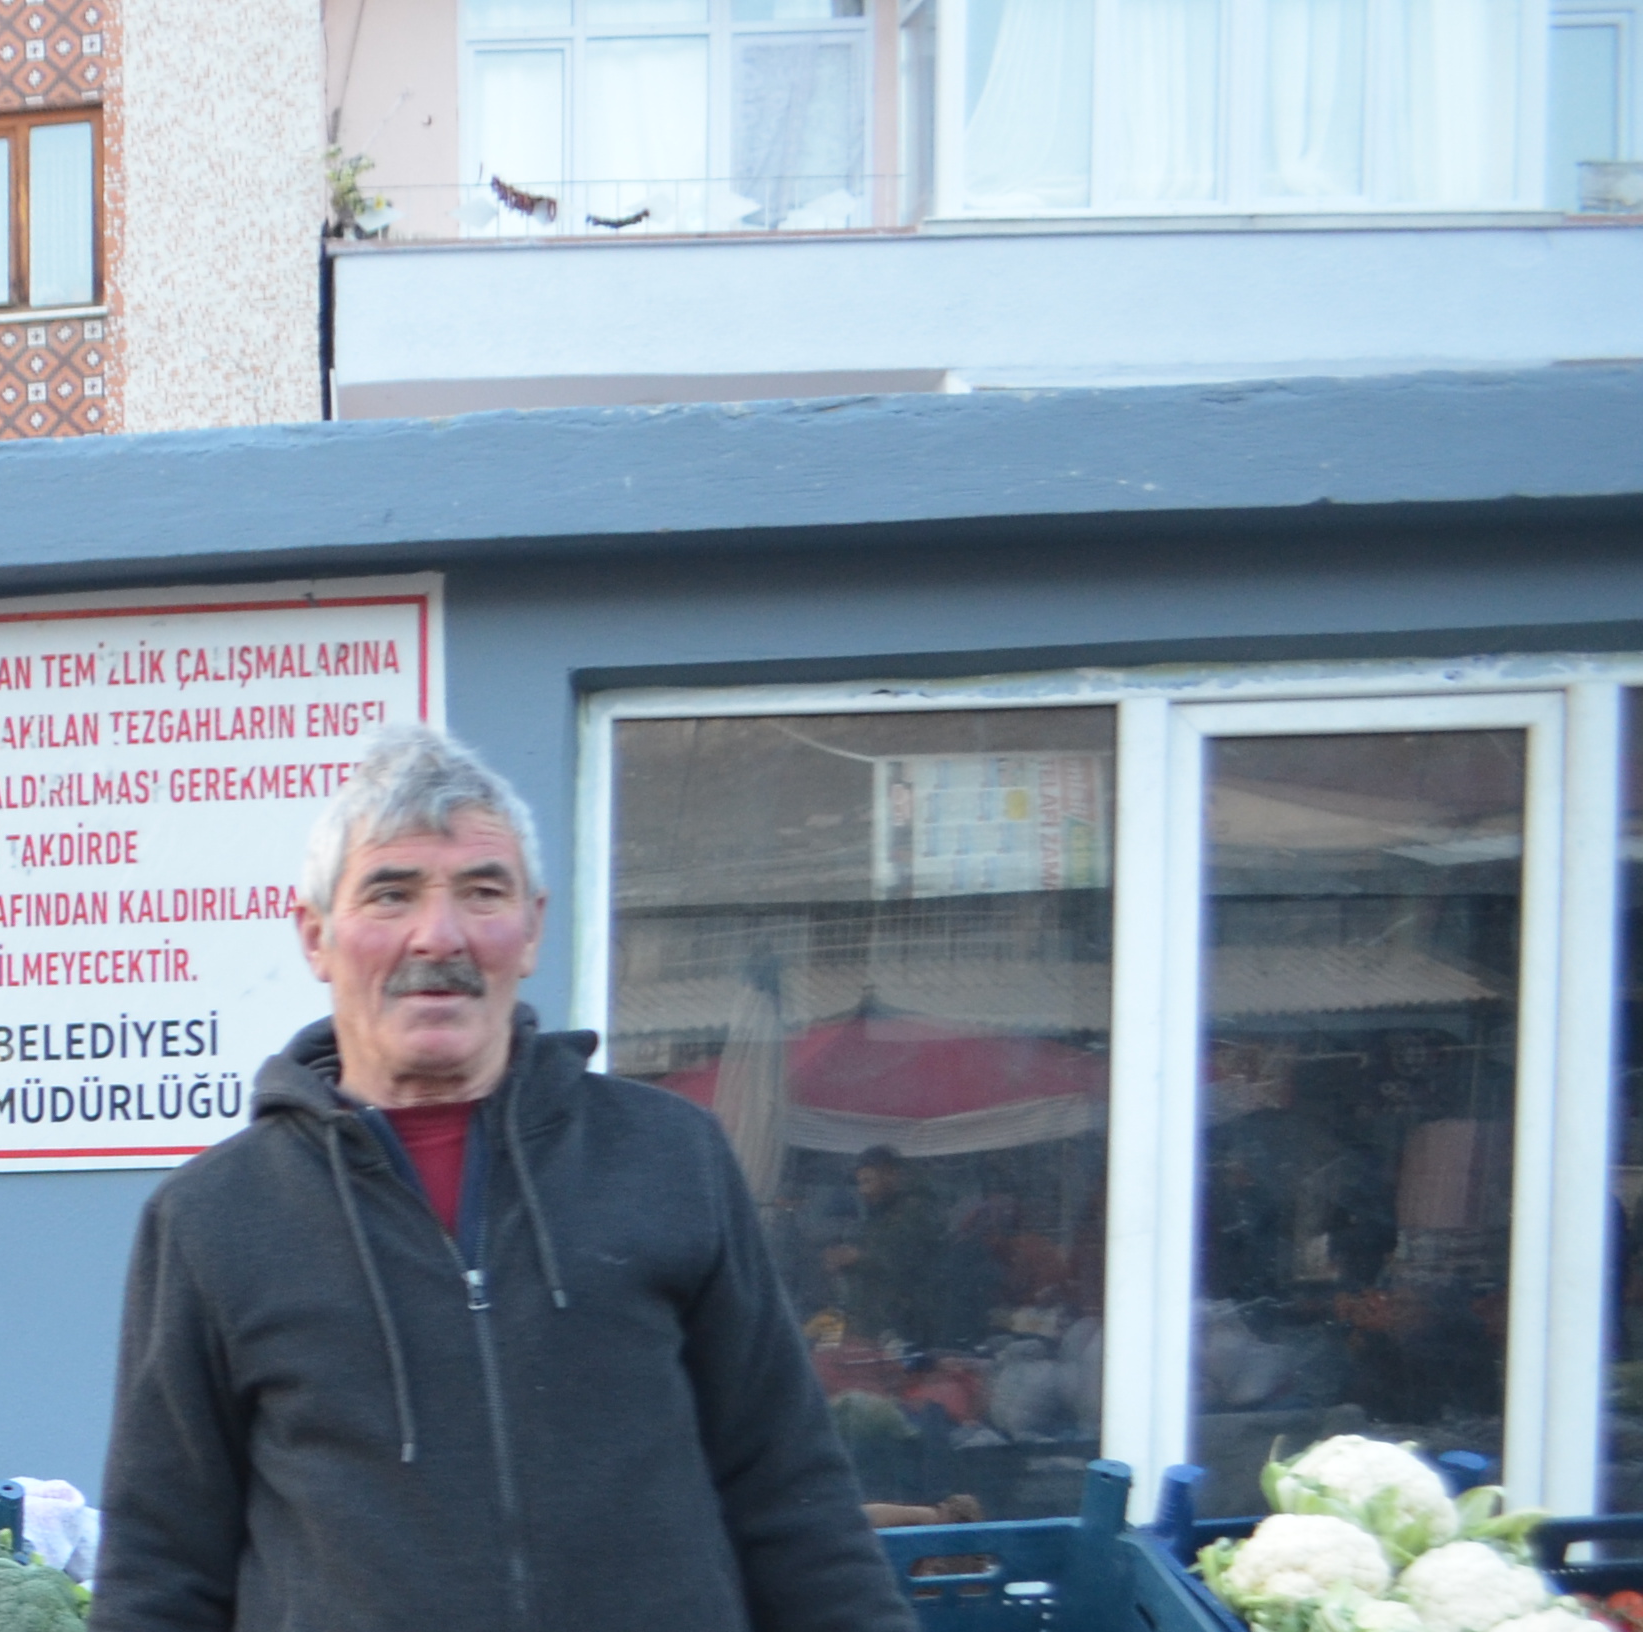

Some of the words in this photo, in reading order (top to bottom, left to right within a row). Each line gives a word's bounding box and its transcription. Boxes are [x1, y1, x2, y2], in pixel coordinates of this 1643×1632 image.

[175, 638, 400, 690] ÇALIŞMALARINA
[109, 704, 296, 746] TEZGAHLARIN
[170, 762, 363, 803] GEREKMEKTE
[5, 822, 139, 868] TAKDİRDE
[119, 884, 299, 924] KALDIRILARA
